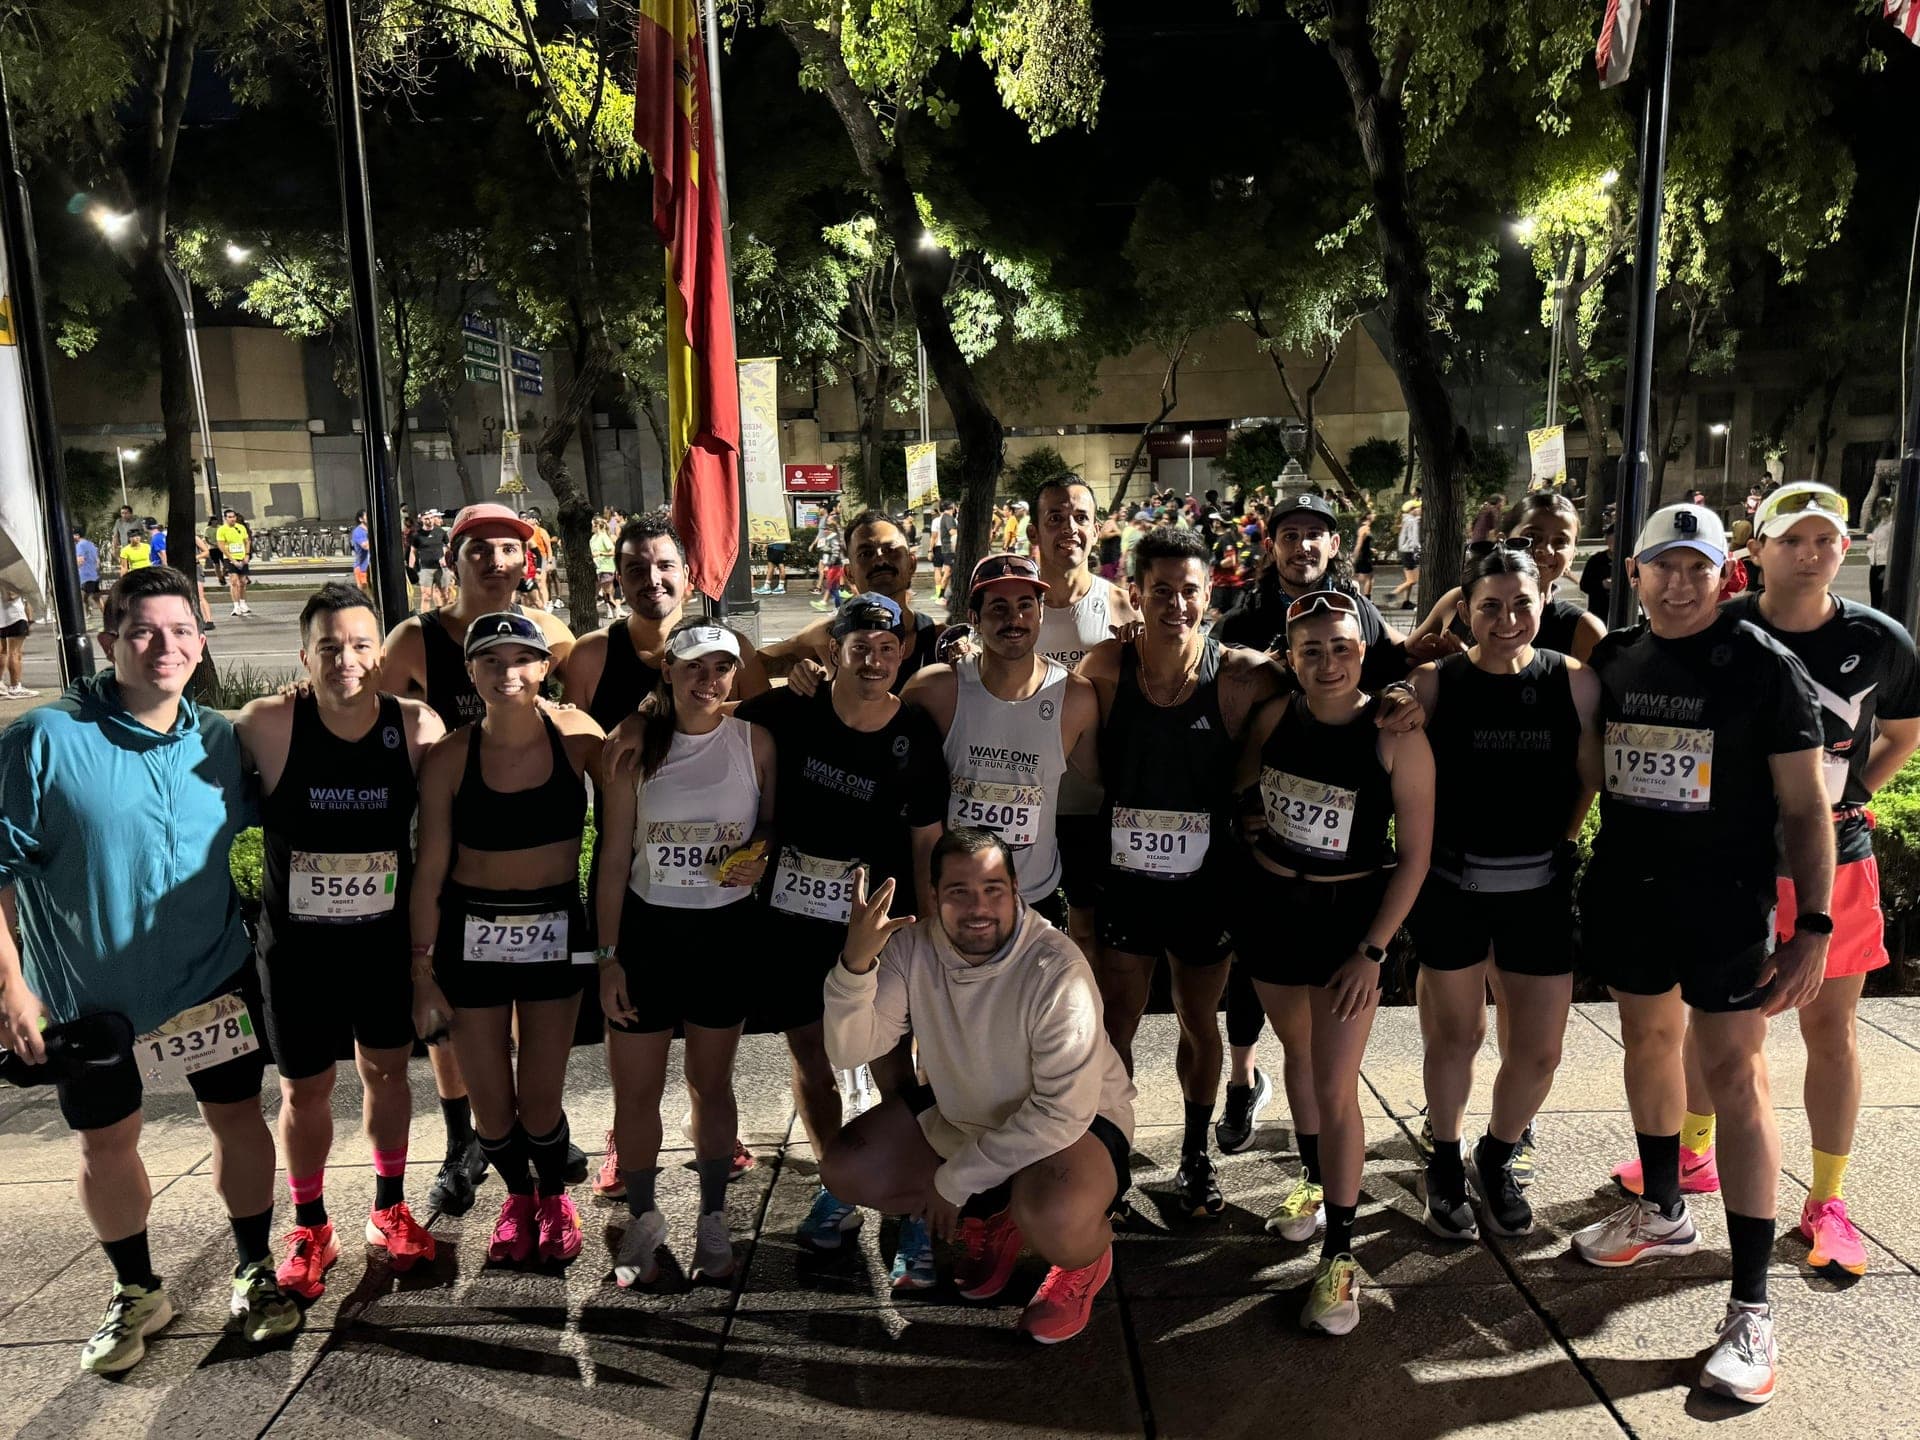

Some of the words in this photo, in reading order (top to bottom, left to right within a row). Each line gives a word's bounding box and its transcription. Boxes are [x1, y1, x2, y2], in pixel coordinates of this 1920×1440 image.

[1042, 651, 1067, 661] AVE
[1070, 651, 1086, 661] ON
[455, 695, 481, 706] WA
[1625, 691, 1668, 709] WAVE
[1670, 697, 1704, 711] ONE
[1622, 705, 1637, 715] WE
[1639, 707, 1661, 718] RUN
[1473, 729, 1517, 741] WAVE
[1520, 729, 1552, 741] ONE
[969, 745, 1008, 761] WAVE
[1010, 750, 1040, 766] ONE
[1615, 749, 1695, 778] 19539
[806, 756, 846, 784] WAVE
[846, 773, 878, 793] ONE
[969, 759, 983, 767] WE
[984, 760, 1004, 769] RUN
[1004, 763, 1017, 772] AS
[1018, 765, 1036, 775] ONE
[803, 769, 818, 784] WE
[819, 777, 838, 791] RUN
[838, 783, 852, 796] AS
[852, 788, 873, 802] ONE
[1632, 776, 1667, 785] FRANCISCO
[309, 787, 356, 801] WAVE
[358, 787, 389, 801] ONE
[310, 801, 326, 810] WE
[328, 802, 350, 810] RUN
[353, 802, 365, 810] AS
[368, 801, 388, 810] ONE
[957, 798, 1030, 827] 25605
[1269, 792, 1340, 829] 22378
[1130, 831, 1188, 854] 5301
[311, 876, 377, 897] 5566
[785, 873, 854, 904] 25835
[477, 924, 556, 945] 27594
[150, 1018, 240, 1062] 13378
[183, 1049, 216, 1063] FERNANDO
